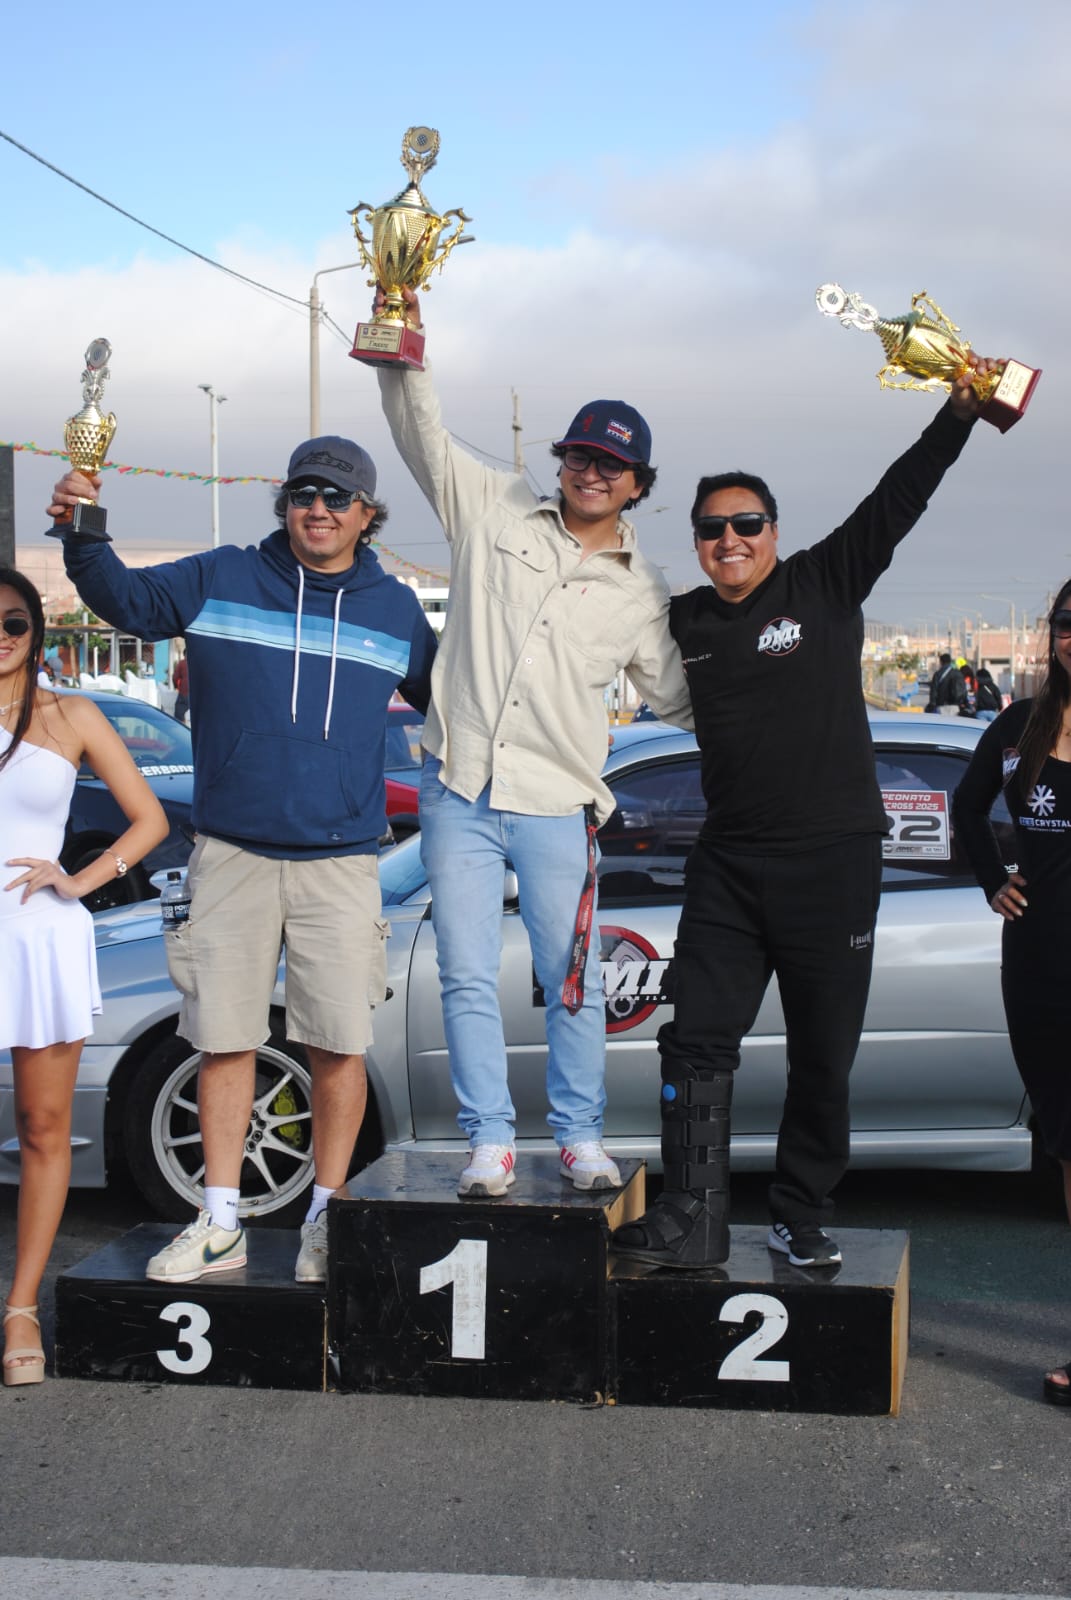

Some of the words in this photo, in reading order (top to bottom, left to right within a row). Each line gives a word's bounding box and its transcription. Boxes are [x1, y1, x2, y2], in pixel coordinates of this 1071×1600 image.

[758, 624, 801, 650] DMI
[886, 814, 941, 842] 2
[1034, 819, 1071, 827] CRYSTAL
[600, 960, 670, 996] MI
[419, 1238, 488, 1360] 1
[156, 1302, 213, 1375] 3
[717, 1293, 790, 1382] 2
